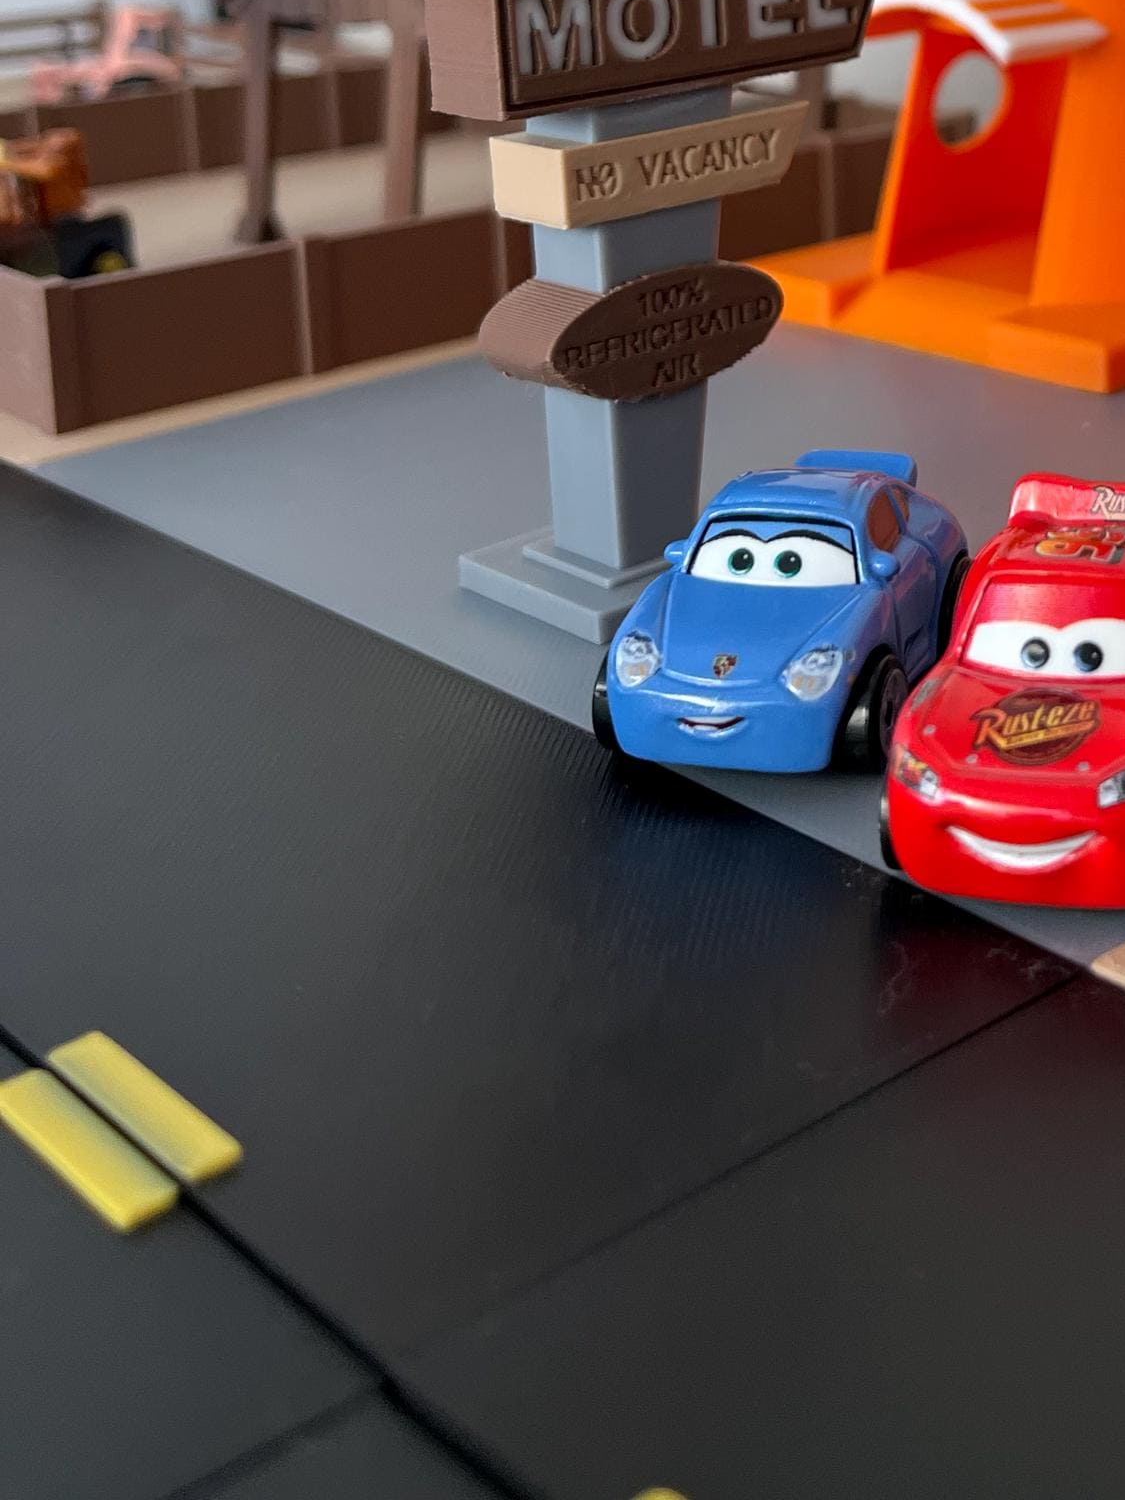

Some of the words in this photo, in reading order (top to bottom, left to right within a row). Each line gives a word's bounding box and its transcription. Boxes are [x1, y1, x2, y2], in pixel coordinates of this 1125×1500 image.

[637, 129, 779, 187] VACANCY
[562, 296, 776, 370] REFRIGERATED
[650, 352, 703, 388] AIR
[970, 700, 1098, 750] Rust-eze
